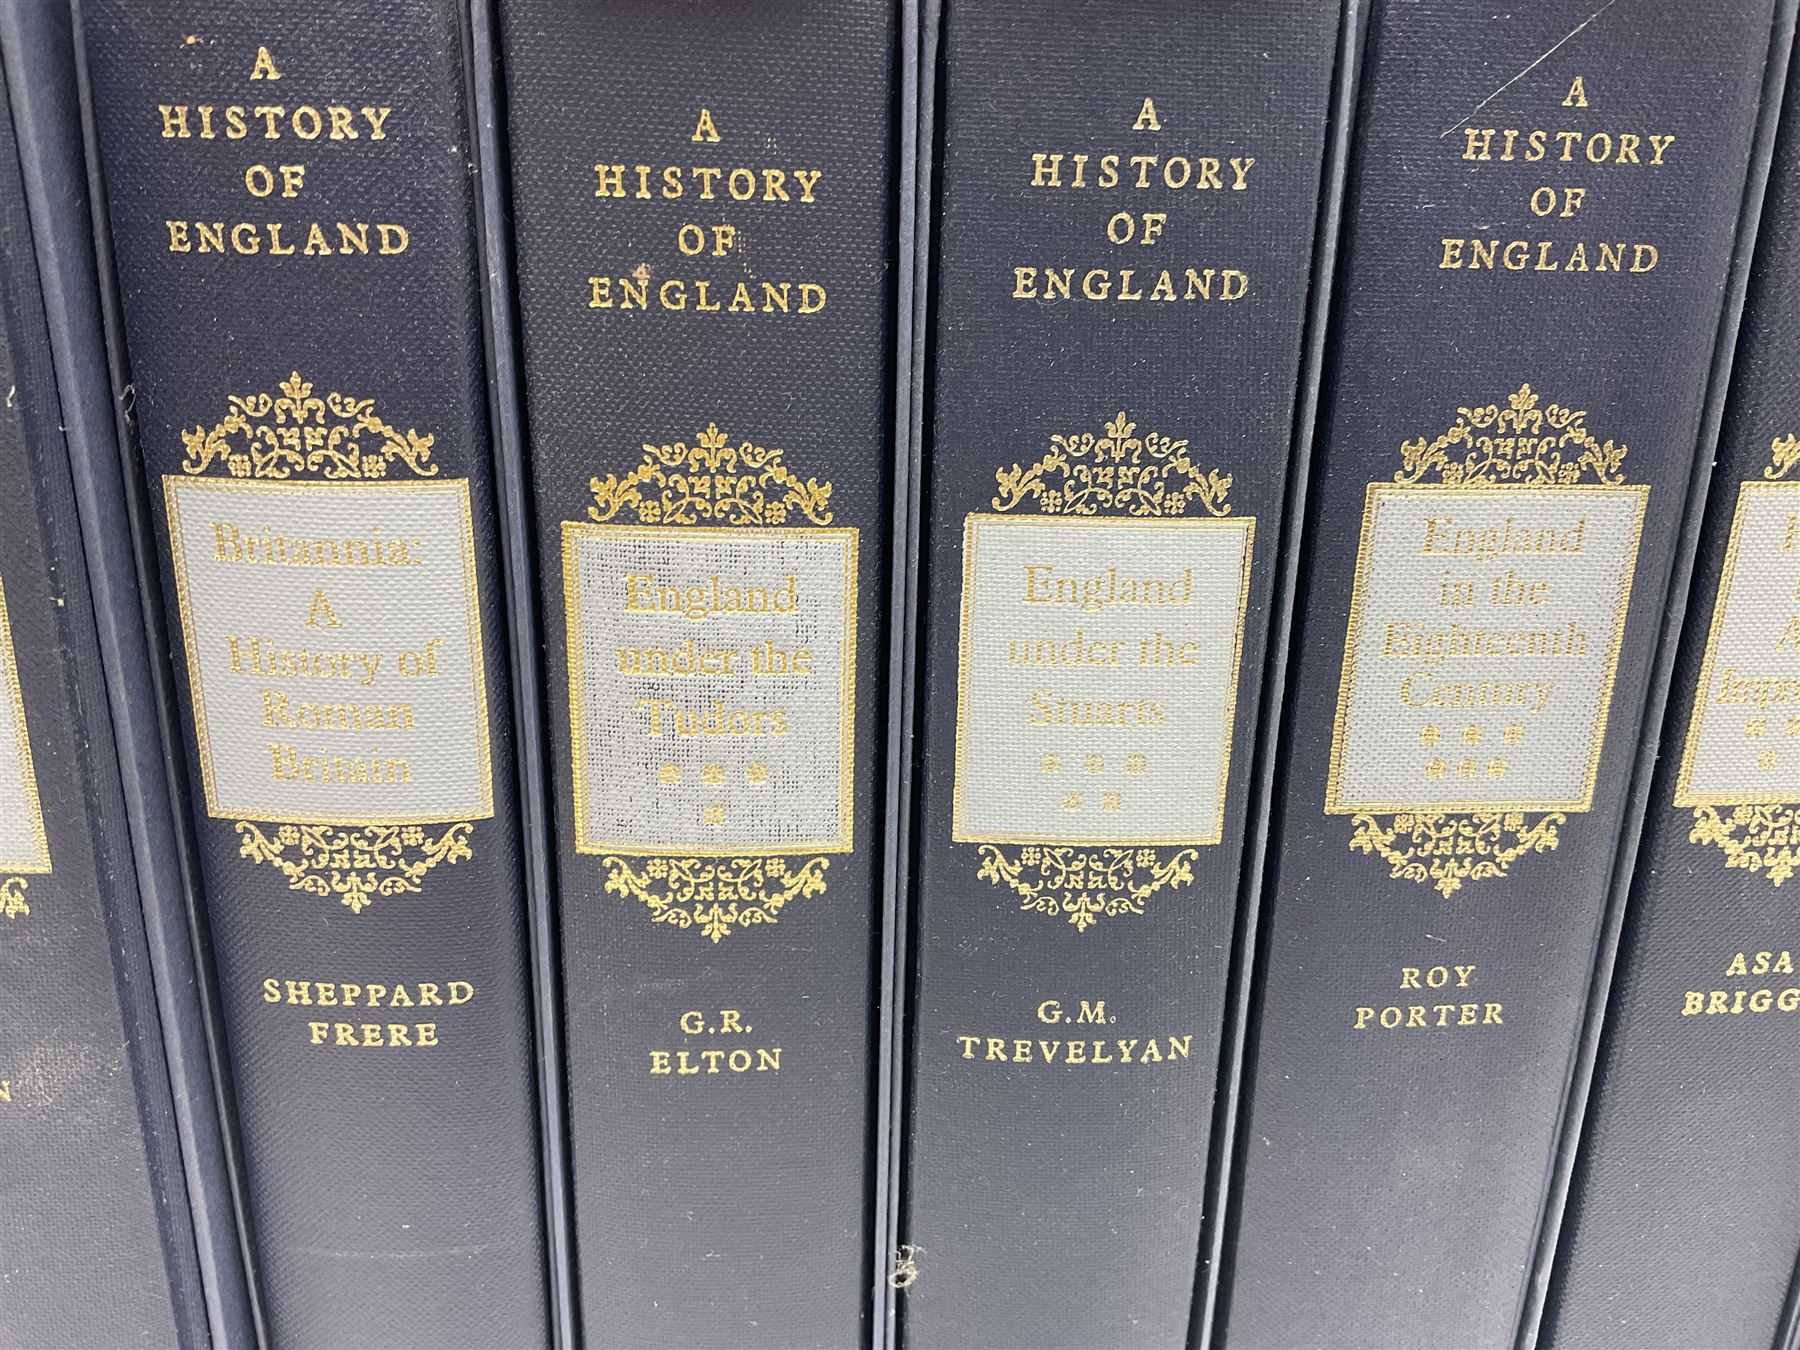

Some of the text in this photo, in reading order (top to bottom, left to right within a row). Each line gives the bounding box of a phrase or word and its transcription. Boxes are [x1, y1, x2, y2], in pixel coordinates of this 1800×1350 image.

[252, 48, 280, 80] A
[1563, 77, 1587, 107] A
[160, 105, 390, 139] HISTORY
[692, 109, 720, 142] A
[1134, 98, 1160, 130] A
[1464, 128, 1674, 165] HISTORY
[245, 165, 304, 197] OF
[594, 164, 822, 202] HISTORY
[1033, 154, 1252, 188] HISTORY
[1531, 188, 1584, 217] OF
[167, 221, 409, 255] ENGLAND
[678, 224, 736, 256] OF
[1107, 212, 1166, 244] OF
[1440, 239, 1658, 272] ENGLAND
[588, 276, 827, 314] ENGLAND
[1014, 267, 1247, 300] ENGLAND
[211, 521, 423, 567] Britannia:
[1422, 517, 1585, 562] England
[623, 573, 799, 622] England
[1022, 565, 1192, 612] England
[1439, 573, 1548, 607] in the
[305, 588, 343, 627] A
[226, 635, 443, 686] History of
[616, 641, 812, 677] under the
[1008, 631, 1198, 668] under the
[1383, 622, 1589, 665] Eighteenth
[1030, 690, 1165, 727] Stuarts
[1401, 672, 1555, 713] Century
[262, 690, 415, 731] Roman
[638, 699, 787, 736] Tudors
[267, 743, 413, 784] Britain
[1402, 965, 1473, 988] ROY
[1727, 952, 1792, 976] ASA
[264, 979, 474, 1007] SHEPPARD
[680, 1010, 752, 1034] G.R.
[1037, 1000, 1117, 1024] G.M.
[1355, 1003, 1503, 1029] PORTER
[310, 1022, 438, 1047] FRERE
[960, 1036, 1191, 1064] TREVELYAN
[650, 1048, 780, 1075] ELTON
